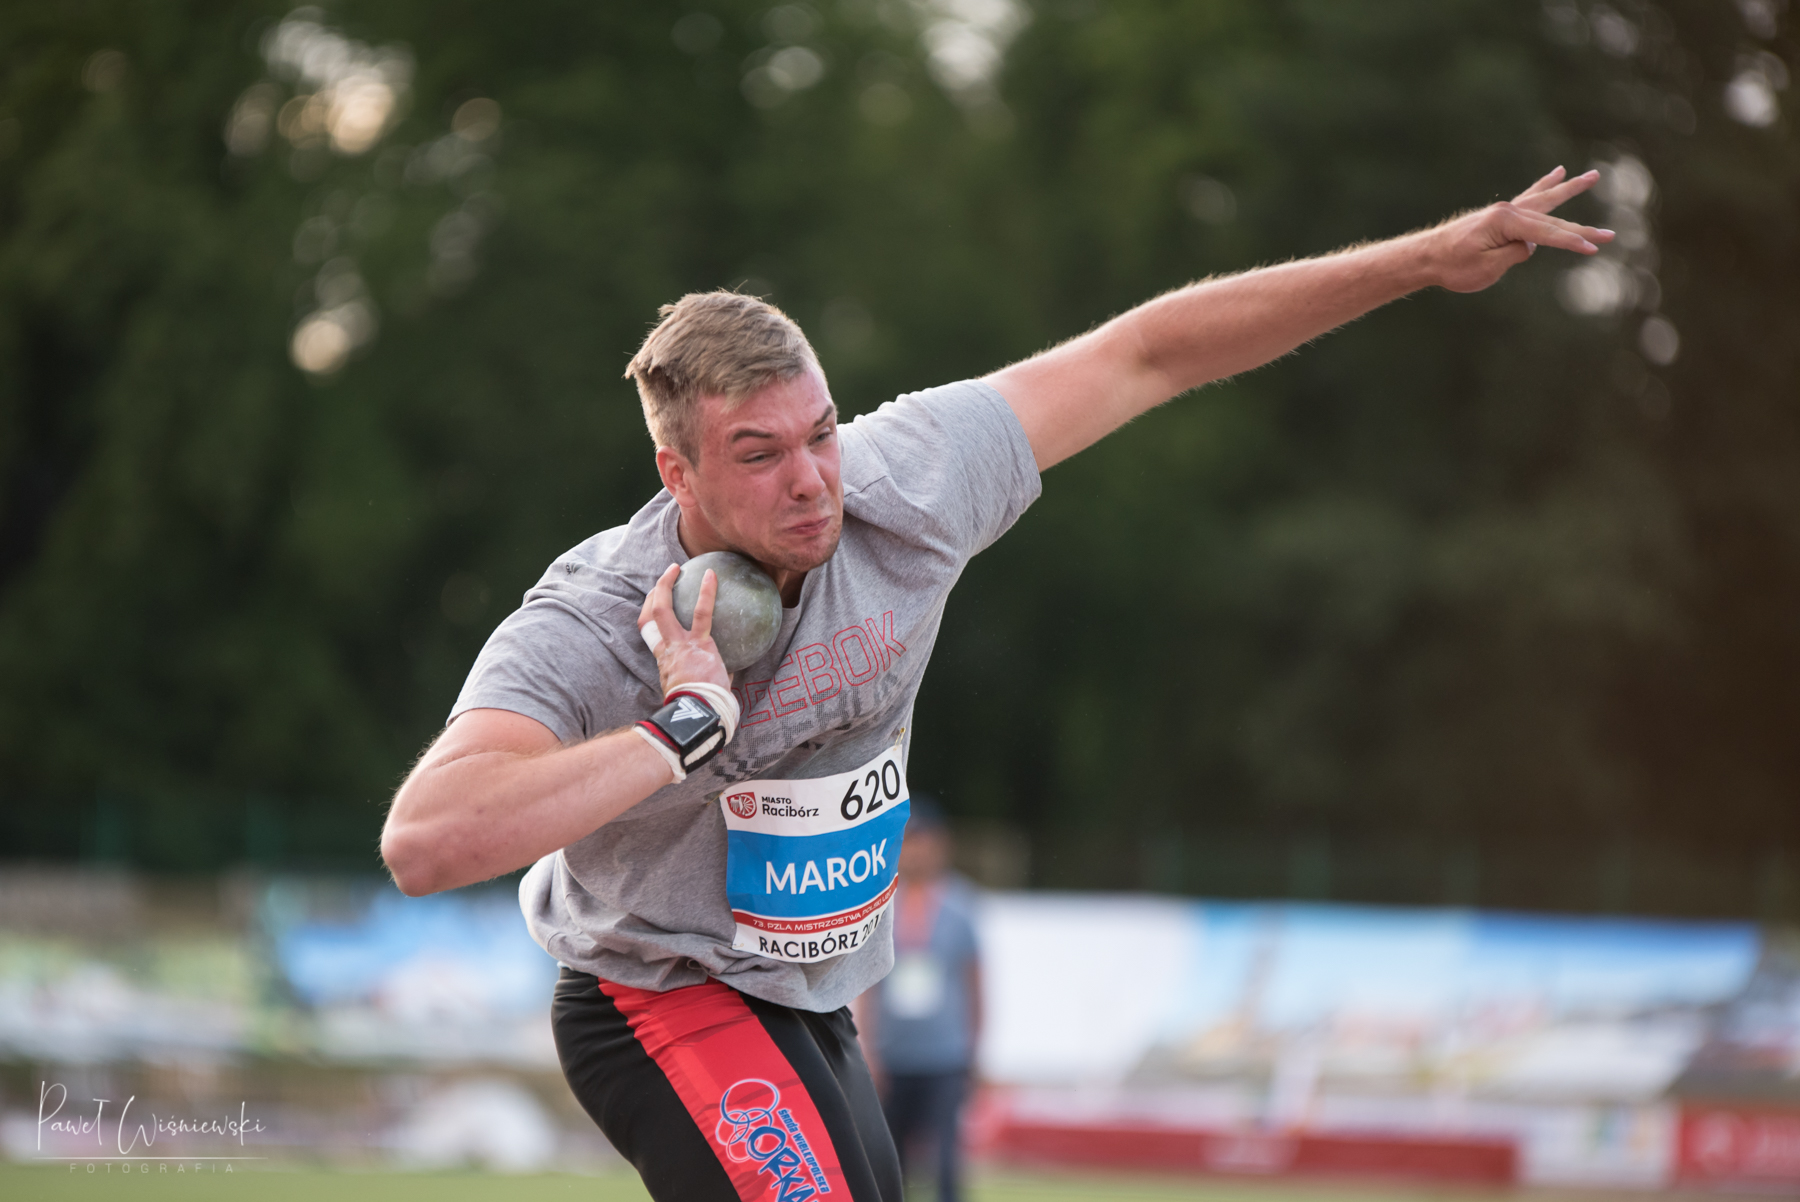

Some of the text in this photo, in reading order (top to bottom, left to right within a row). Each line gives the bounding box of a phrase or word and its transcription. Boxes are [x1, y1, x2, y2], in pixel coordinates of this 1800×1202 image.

[731, 610, 907, 729] EEBOK
[761, 796, 792, 805] MIASTO
[762, 803, 820, 818] Racibórz
[840, 759, 900, 821] 620
[765, 838, 887, 895] MAROK
[752, 919, 766, 928] 73.
[767, 923, 792, 931] PZLA
[794, 912, 862, 931] MISTRZOSTWA
[758, 910, 886, 959] RACIBÓRZ 201
